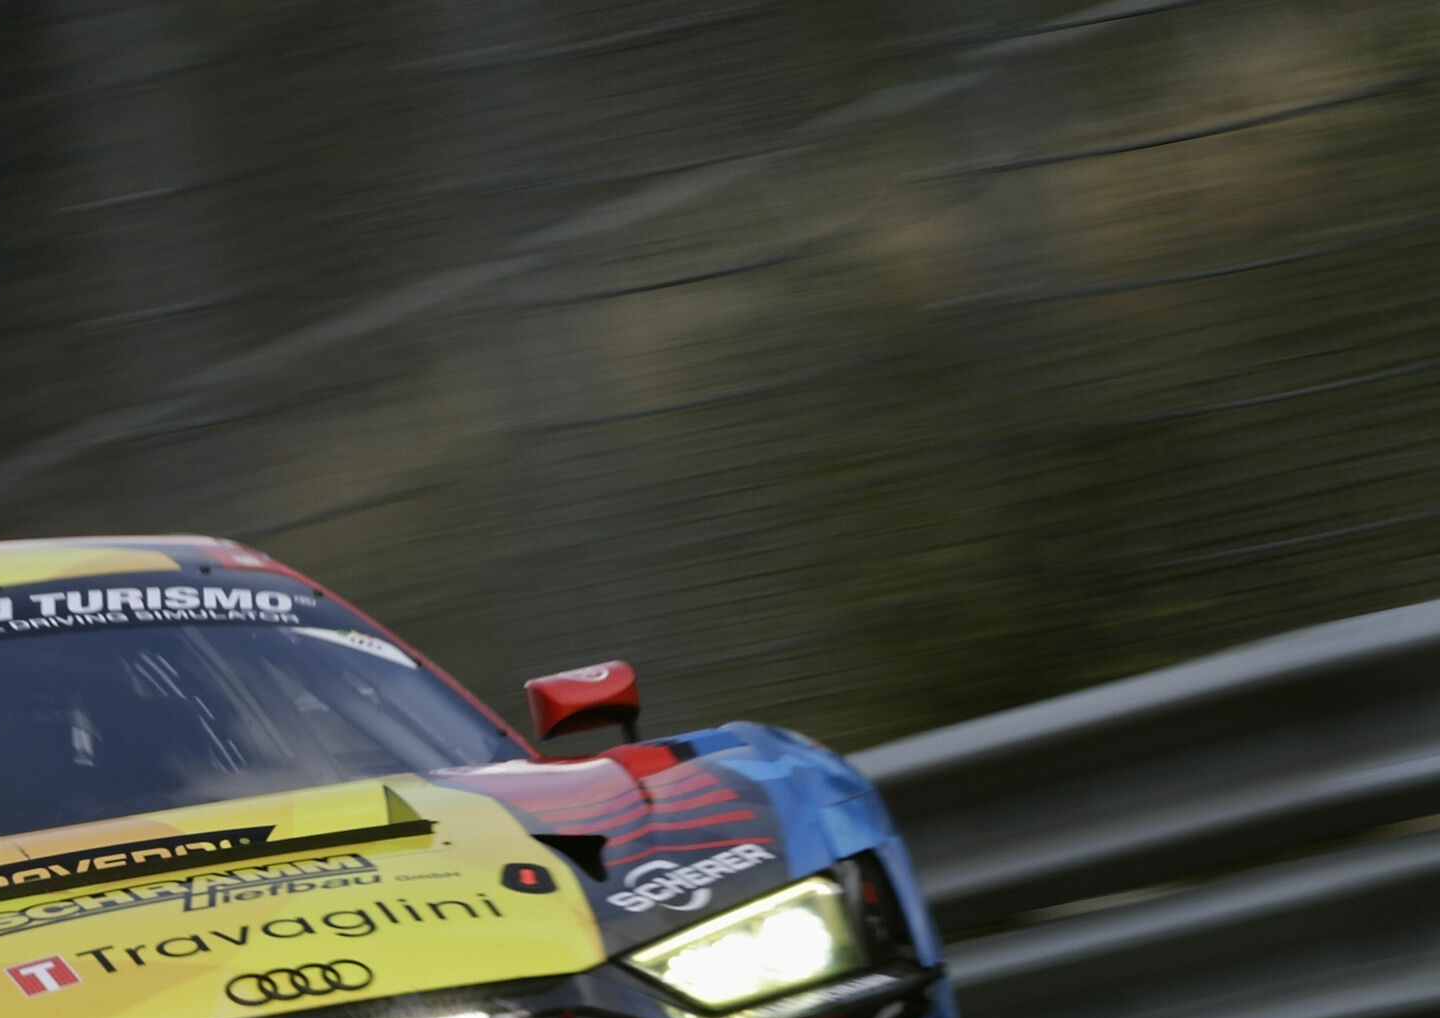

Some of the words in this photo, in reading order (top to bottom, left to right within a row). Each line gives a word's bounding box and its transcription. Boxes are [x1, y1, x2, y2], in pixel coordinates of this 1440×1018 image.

[8, 612, 129, 631] DRIVING
[135, 608, 300, 624] SIMULATOR
[29, 586, 293, 618] TURISMO
[606, 843, 777, 912] SCHERER
[75, 892, 504, 976] Travaglini
